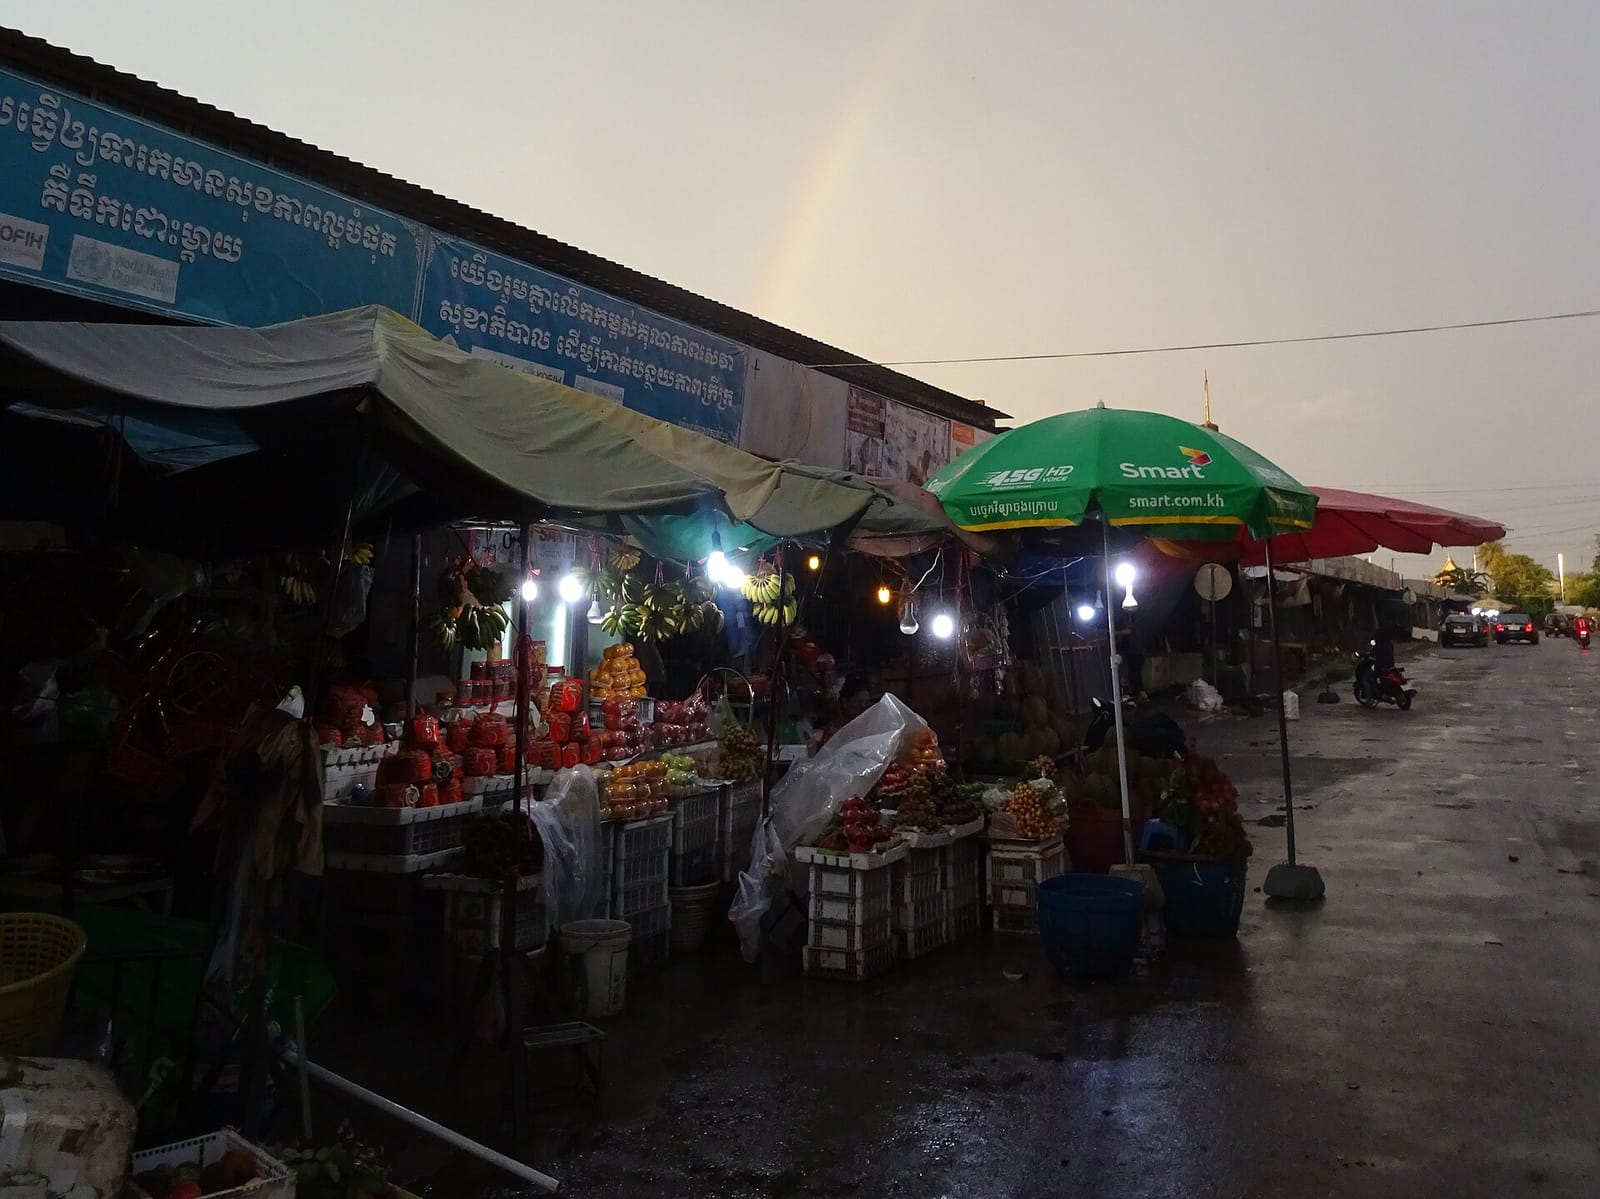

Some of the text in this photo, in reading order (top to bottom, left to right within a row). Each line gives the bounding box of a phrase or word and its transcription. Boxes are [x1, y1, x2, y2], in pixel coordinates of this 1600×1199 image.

[988, 465, 1074, 486] 4.5G HD
[1043, 475, 1069, 483] VOICE
[1119, 463, 1205, 479] Smart
[1128, 493, 1225, 508] smart.com.kh
[970, 500, 1058, 518] បច្ចេកវិទ្យាចុងក្រោយ
